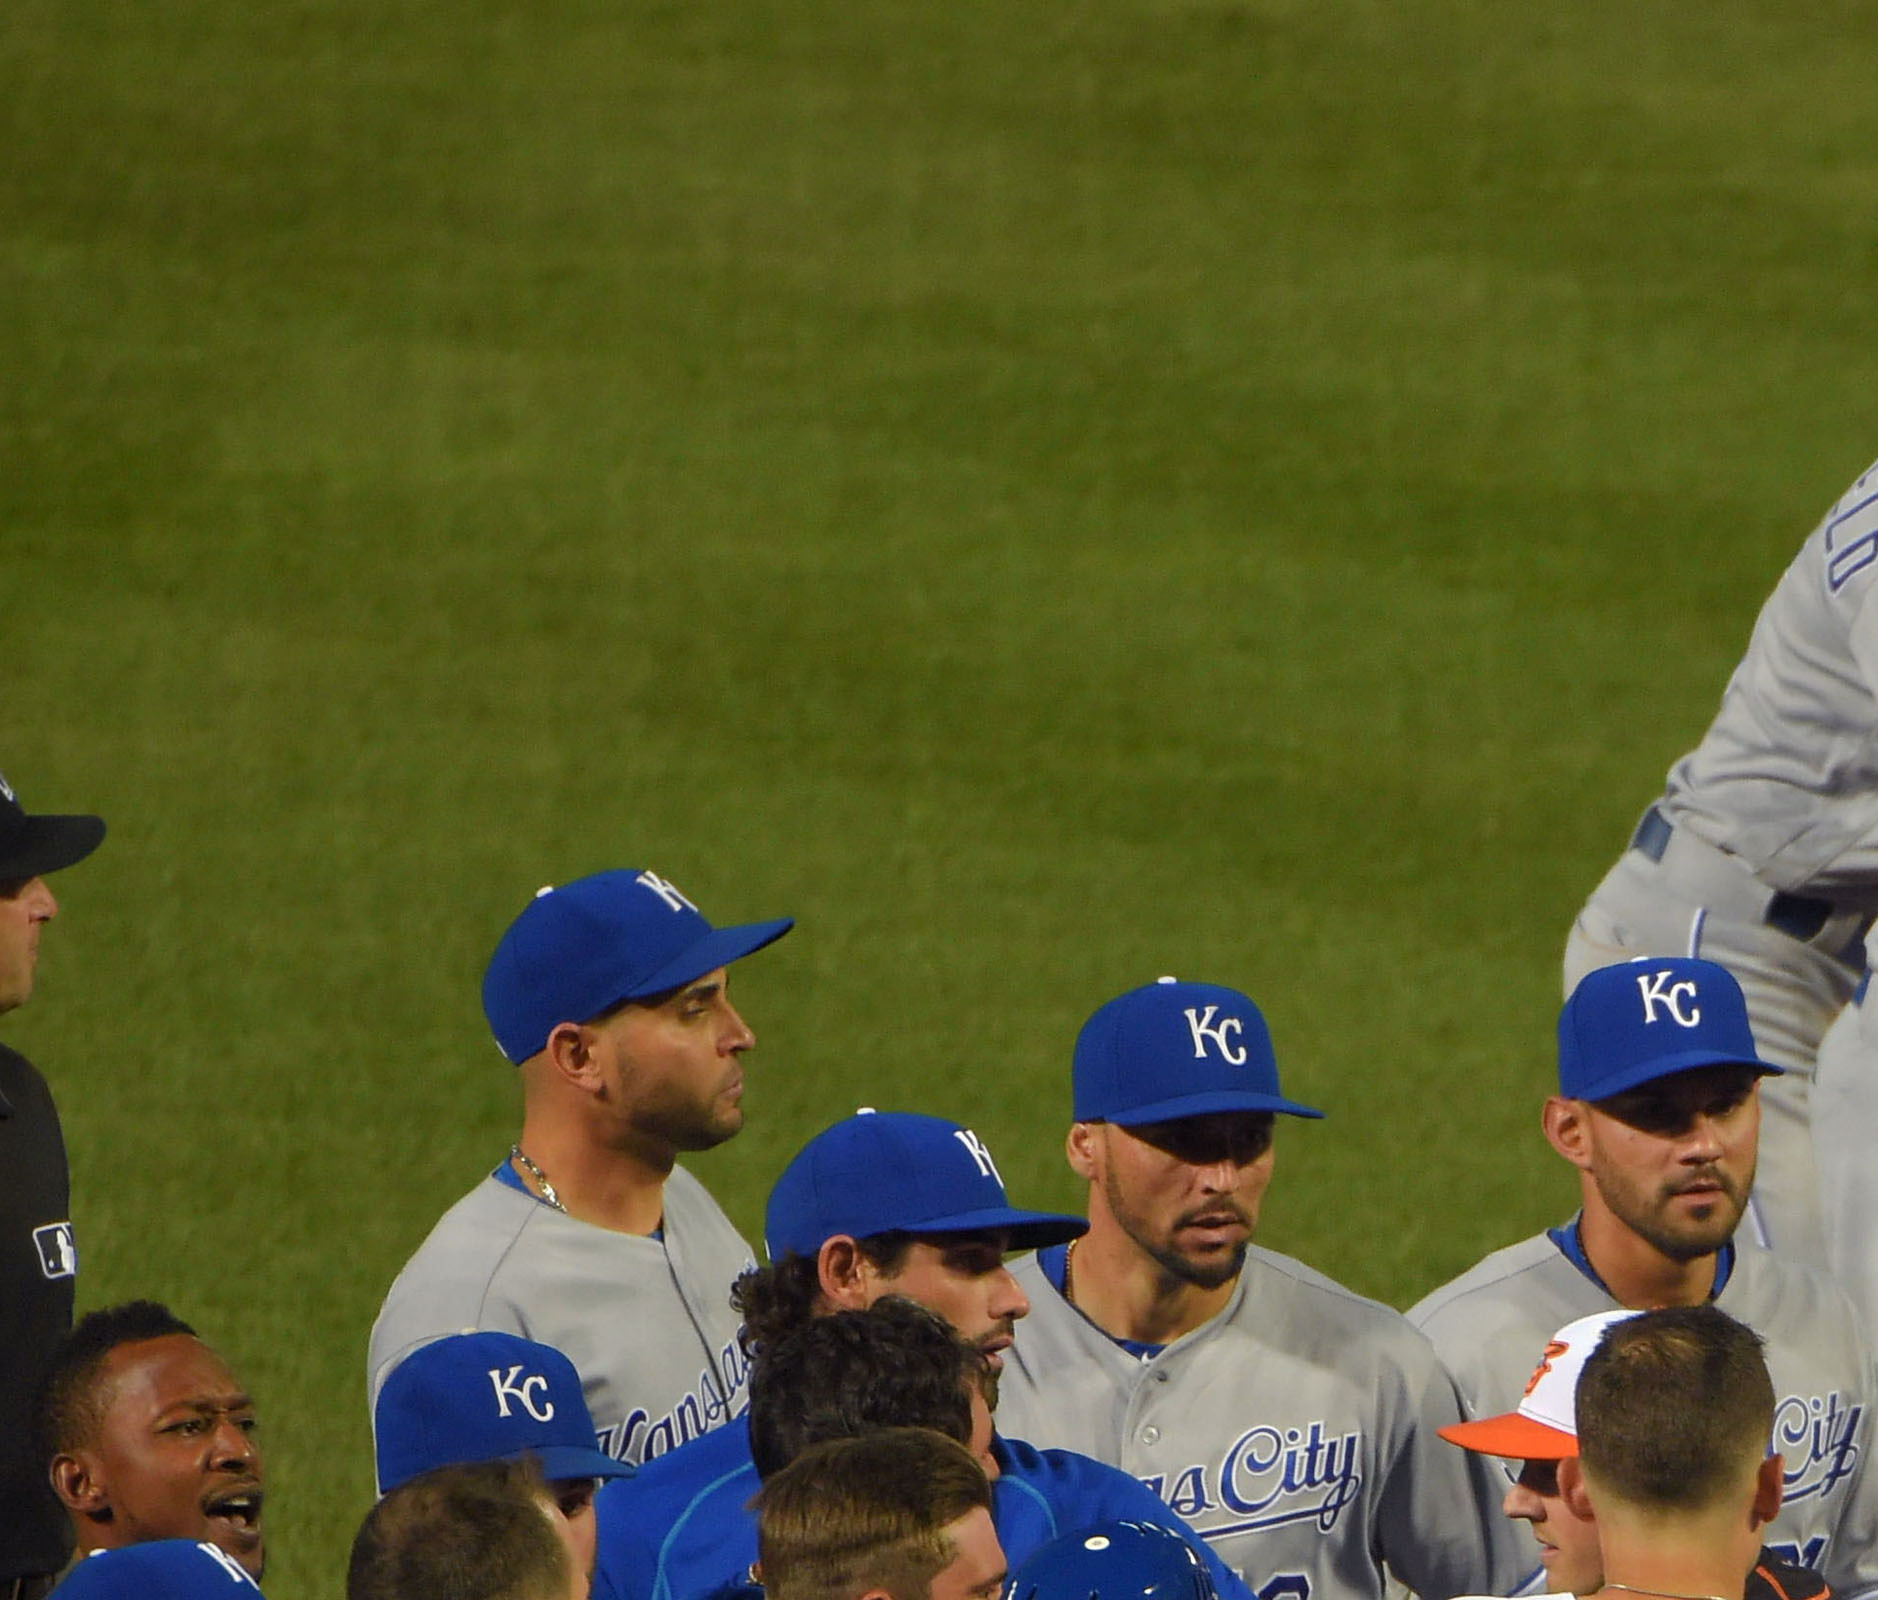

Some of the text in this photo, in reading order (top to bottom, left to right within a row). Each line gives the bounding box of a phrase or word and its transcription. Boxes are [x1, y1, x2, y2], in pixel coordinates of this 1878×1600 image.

[1637, 970, 1700, 1028] KC
[1183, 1005, 1247, 1066] KC
[488, 1364, 555, 1422] KC
[1767, 1391, 1866, 1500] City
[1218, 1420, 1363, 1535] City
